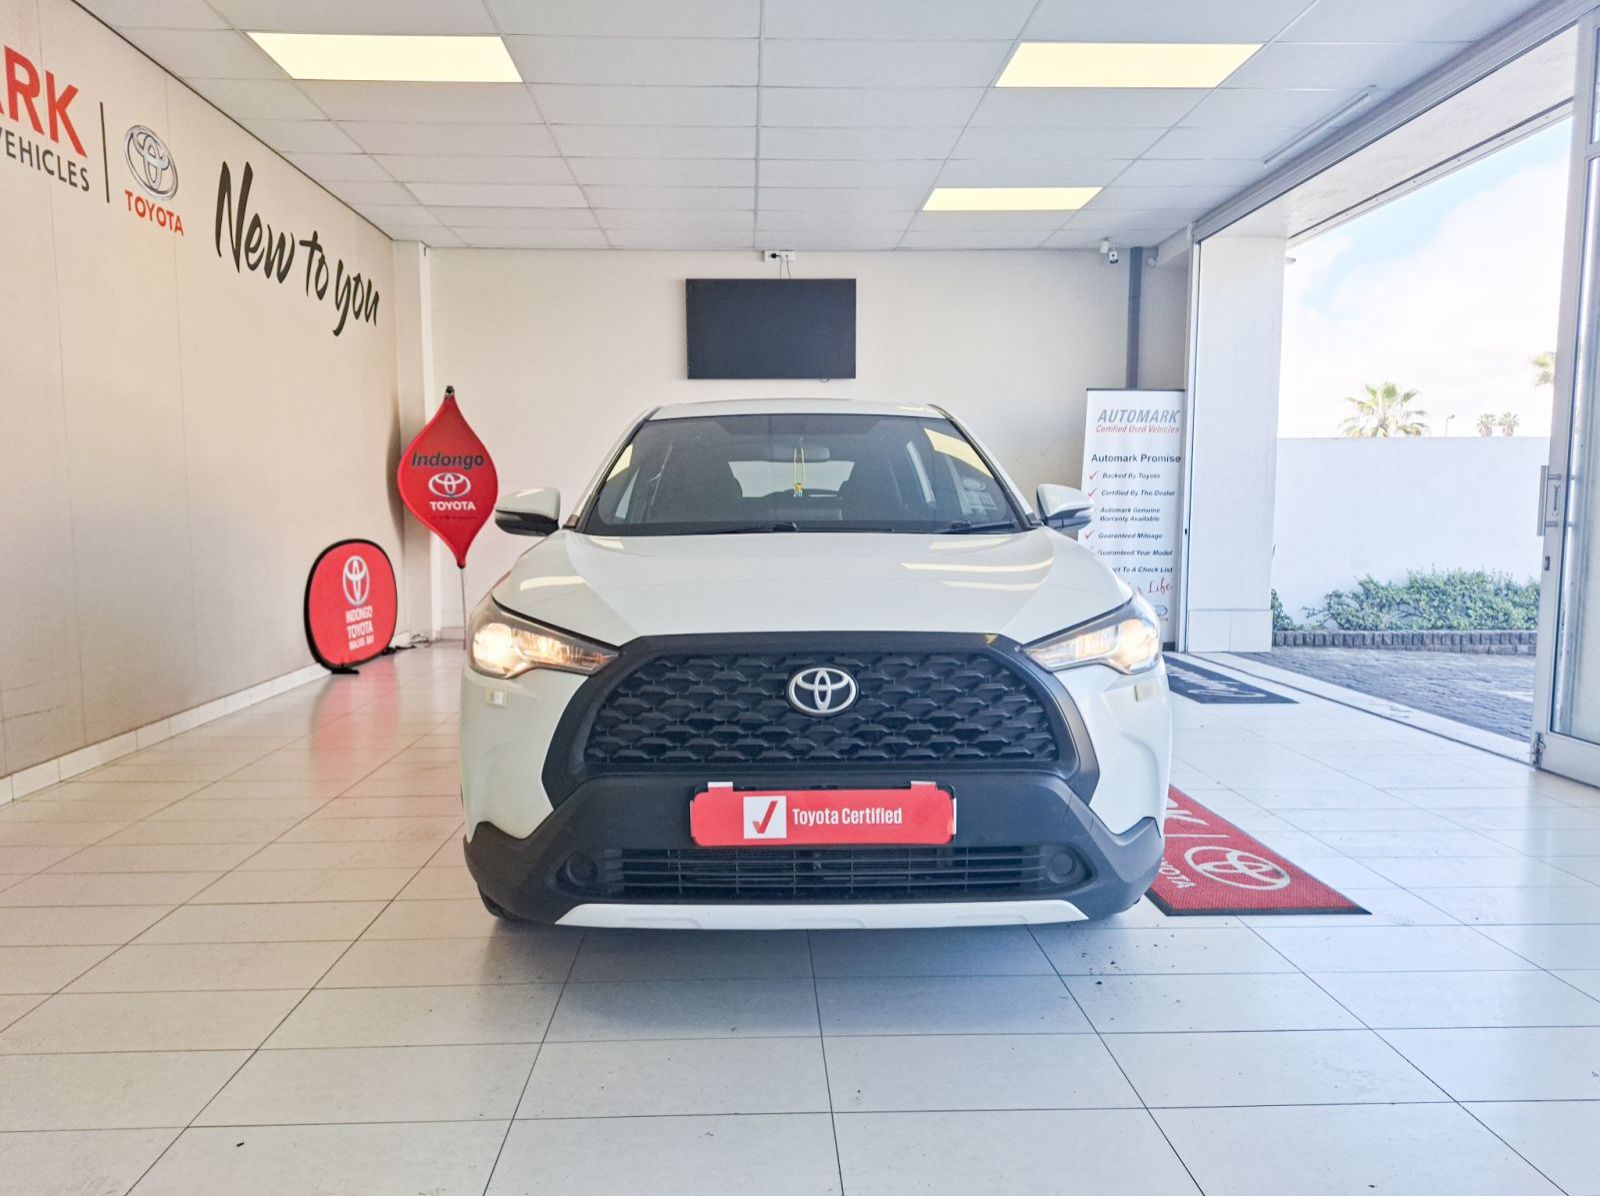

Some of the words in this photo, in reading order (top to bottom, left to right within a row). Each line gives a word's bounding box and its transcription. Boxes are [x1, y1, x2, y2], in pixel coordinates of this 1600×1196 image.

[0, 45, 88, 158] RK
[0, 126, 90, 193] EHICLES
[125, 189, 185, 237] TOYOTA
[214, 160, 296, 284] New
[298, 230, 330, 301] to
[331, 259, 380, 337] you
[1096, 408, 1181, 423] AUTOMARK
[1095, 424, 1127, 434] Certified
[1128, 424, 1146, 433] Used
[1148, 424, 1180, 434] Vehicles
[411, 451, 485, 470] Indongo
[1090, 453, 1137, 463] Automark
[1140, 453, 1182, 463] Promise
[1138, 472, 1161, 480] Toyota
[1101, 489, 1129, 497] Certified
[1140, 489, 1153, 497] The
[1154, 489, 1176, 497] Dealer
[429, 500, 476, 511] TOYOTA
[1100, 506, 1132, 514] Automark
[1132, 506, 1161, 514] Genuine
[1099, 515, 1128, 523] Warranty
[1130, 515, 1160, 523] Available
[1098, 532, 1136, 540] Guaranteed
[1137, 532, 1163, 541] Mileage
[1097, 549, 1135, 557] Guaranteed
[1136, 549, 1151, 557] Year
[1152, 549, 1173, 557] Model
[1148, 576, 1173, 595] Life
[792, 807, 839, 826] Toyota
[841, 806, 903, 825] Certified
